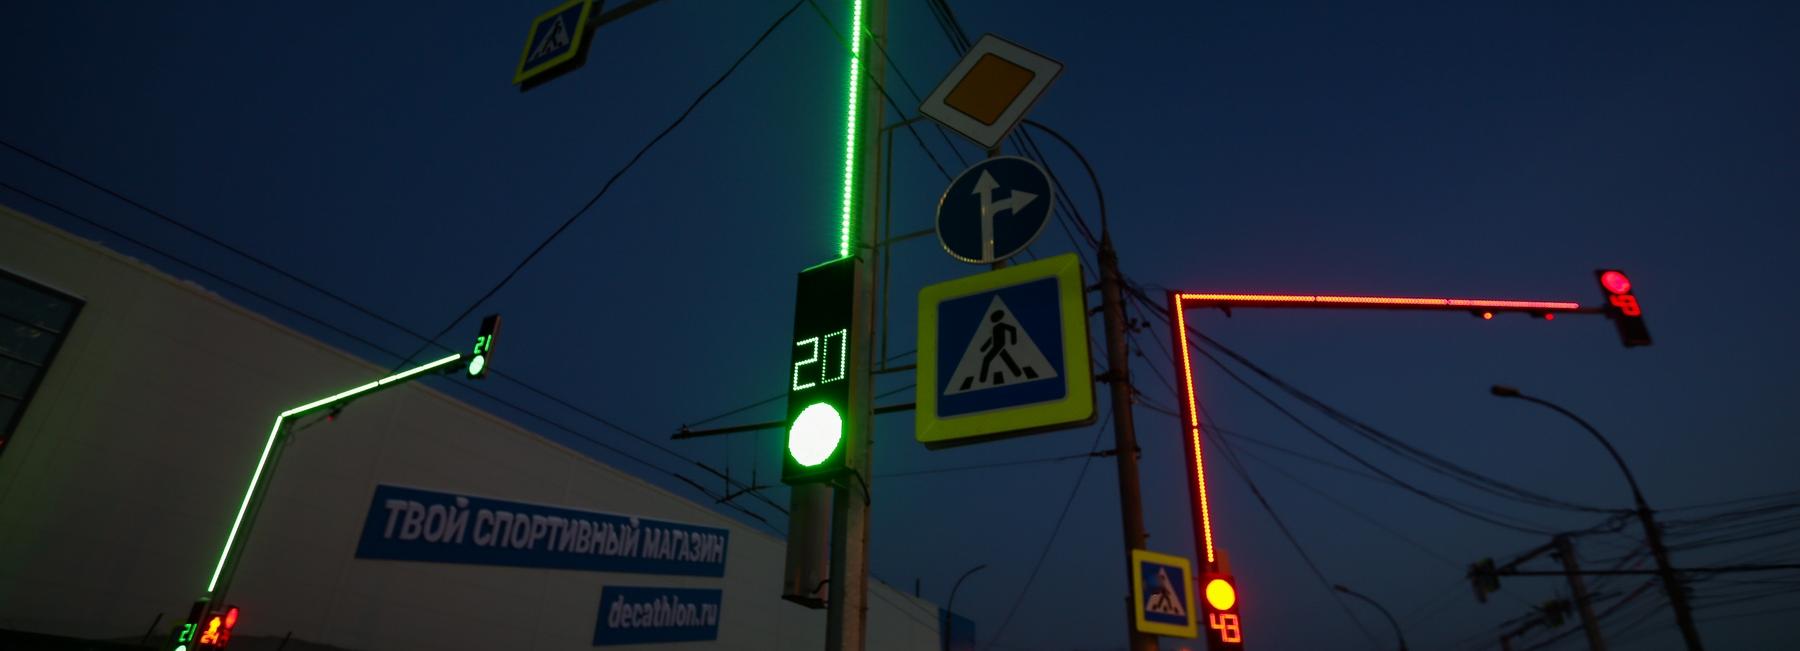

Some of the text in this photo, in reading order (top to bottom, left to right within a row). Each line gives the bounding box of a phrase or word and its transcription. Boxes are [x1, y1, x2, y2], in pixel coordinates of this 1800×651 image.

[474, 334, 492, 354] 21
[793, 329, 847, 391] 20
[383, 497, 725, 564] ТВОЙ СПОРТИВНЫЙ МАГАЗИН
[607, 595, 717, 629] decathlon.ru
[178, 623, 198, 642] 21
